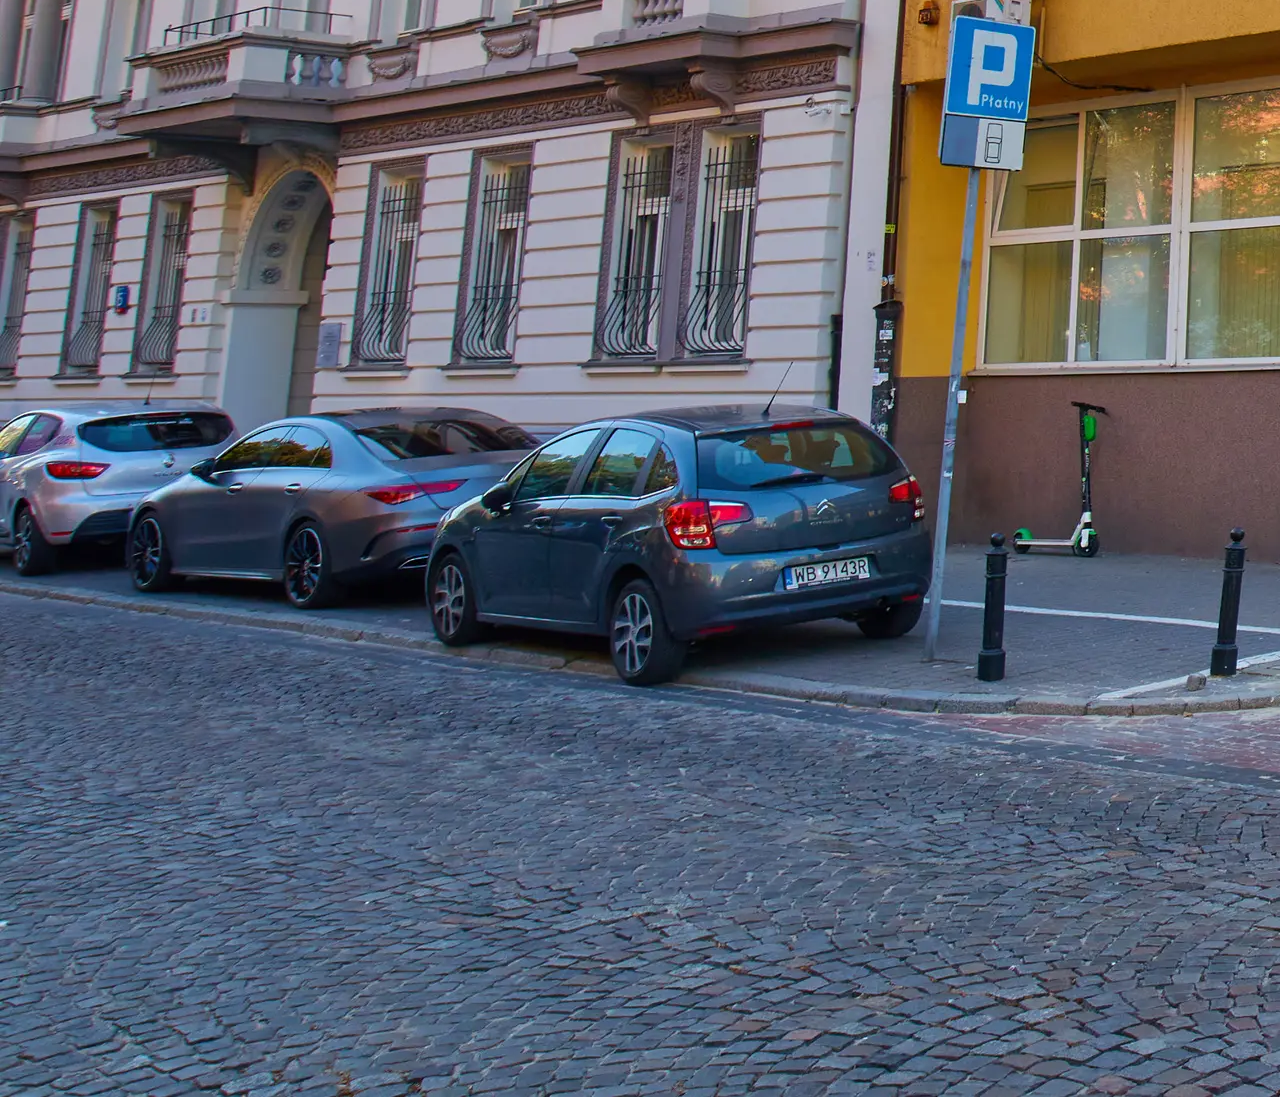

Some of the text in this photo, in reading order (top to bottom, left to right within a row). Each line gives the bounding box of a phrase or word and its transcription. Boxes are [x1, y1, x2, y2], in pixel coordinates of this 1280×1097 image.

[967, 28, 1018, 106] P
[981, 94, 1024, 113] Płatny
[795, 566, 817, 583] WB
[822, 559, 867, 580] 9143R
